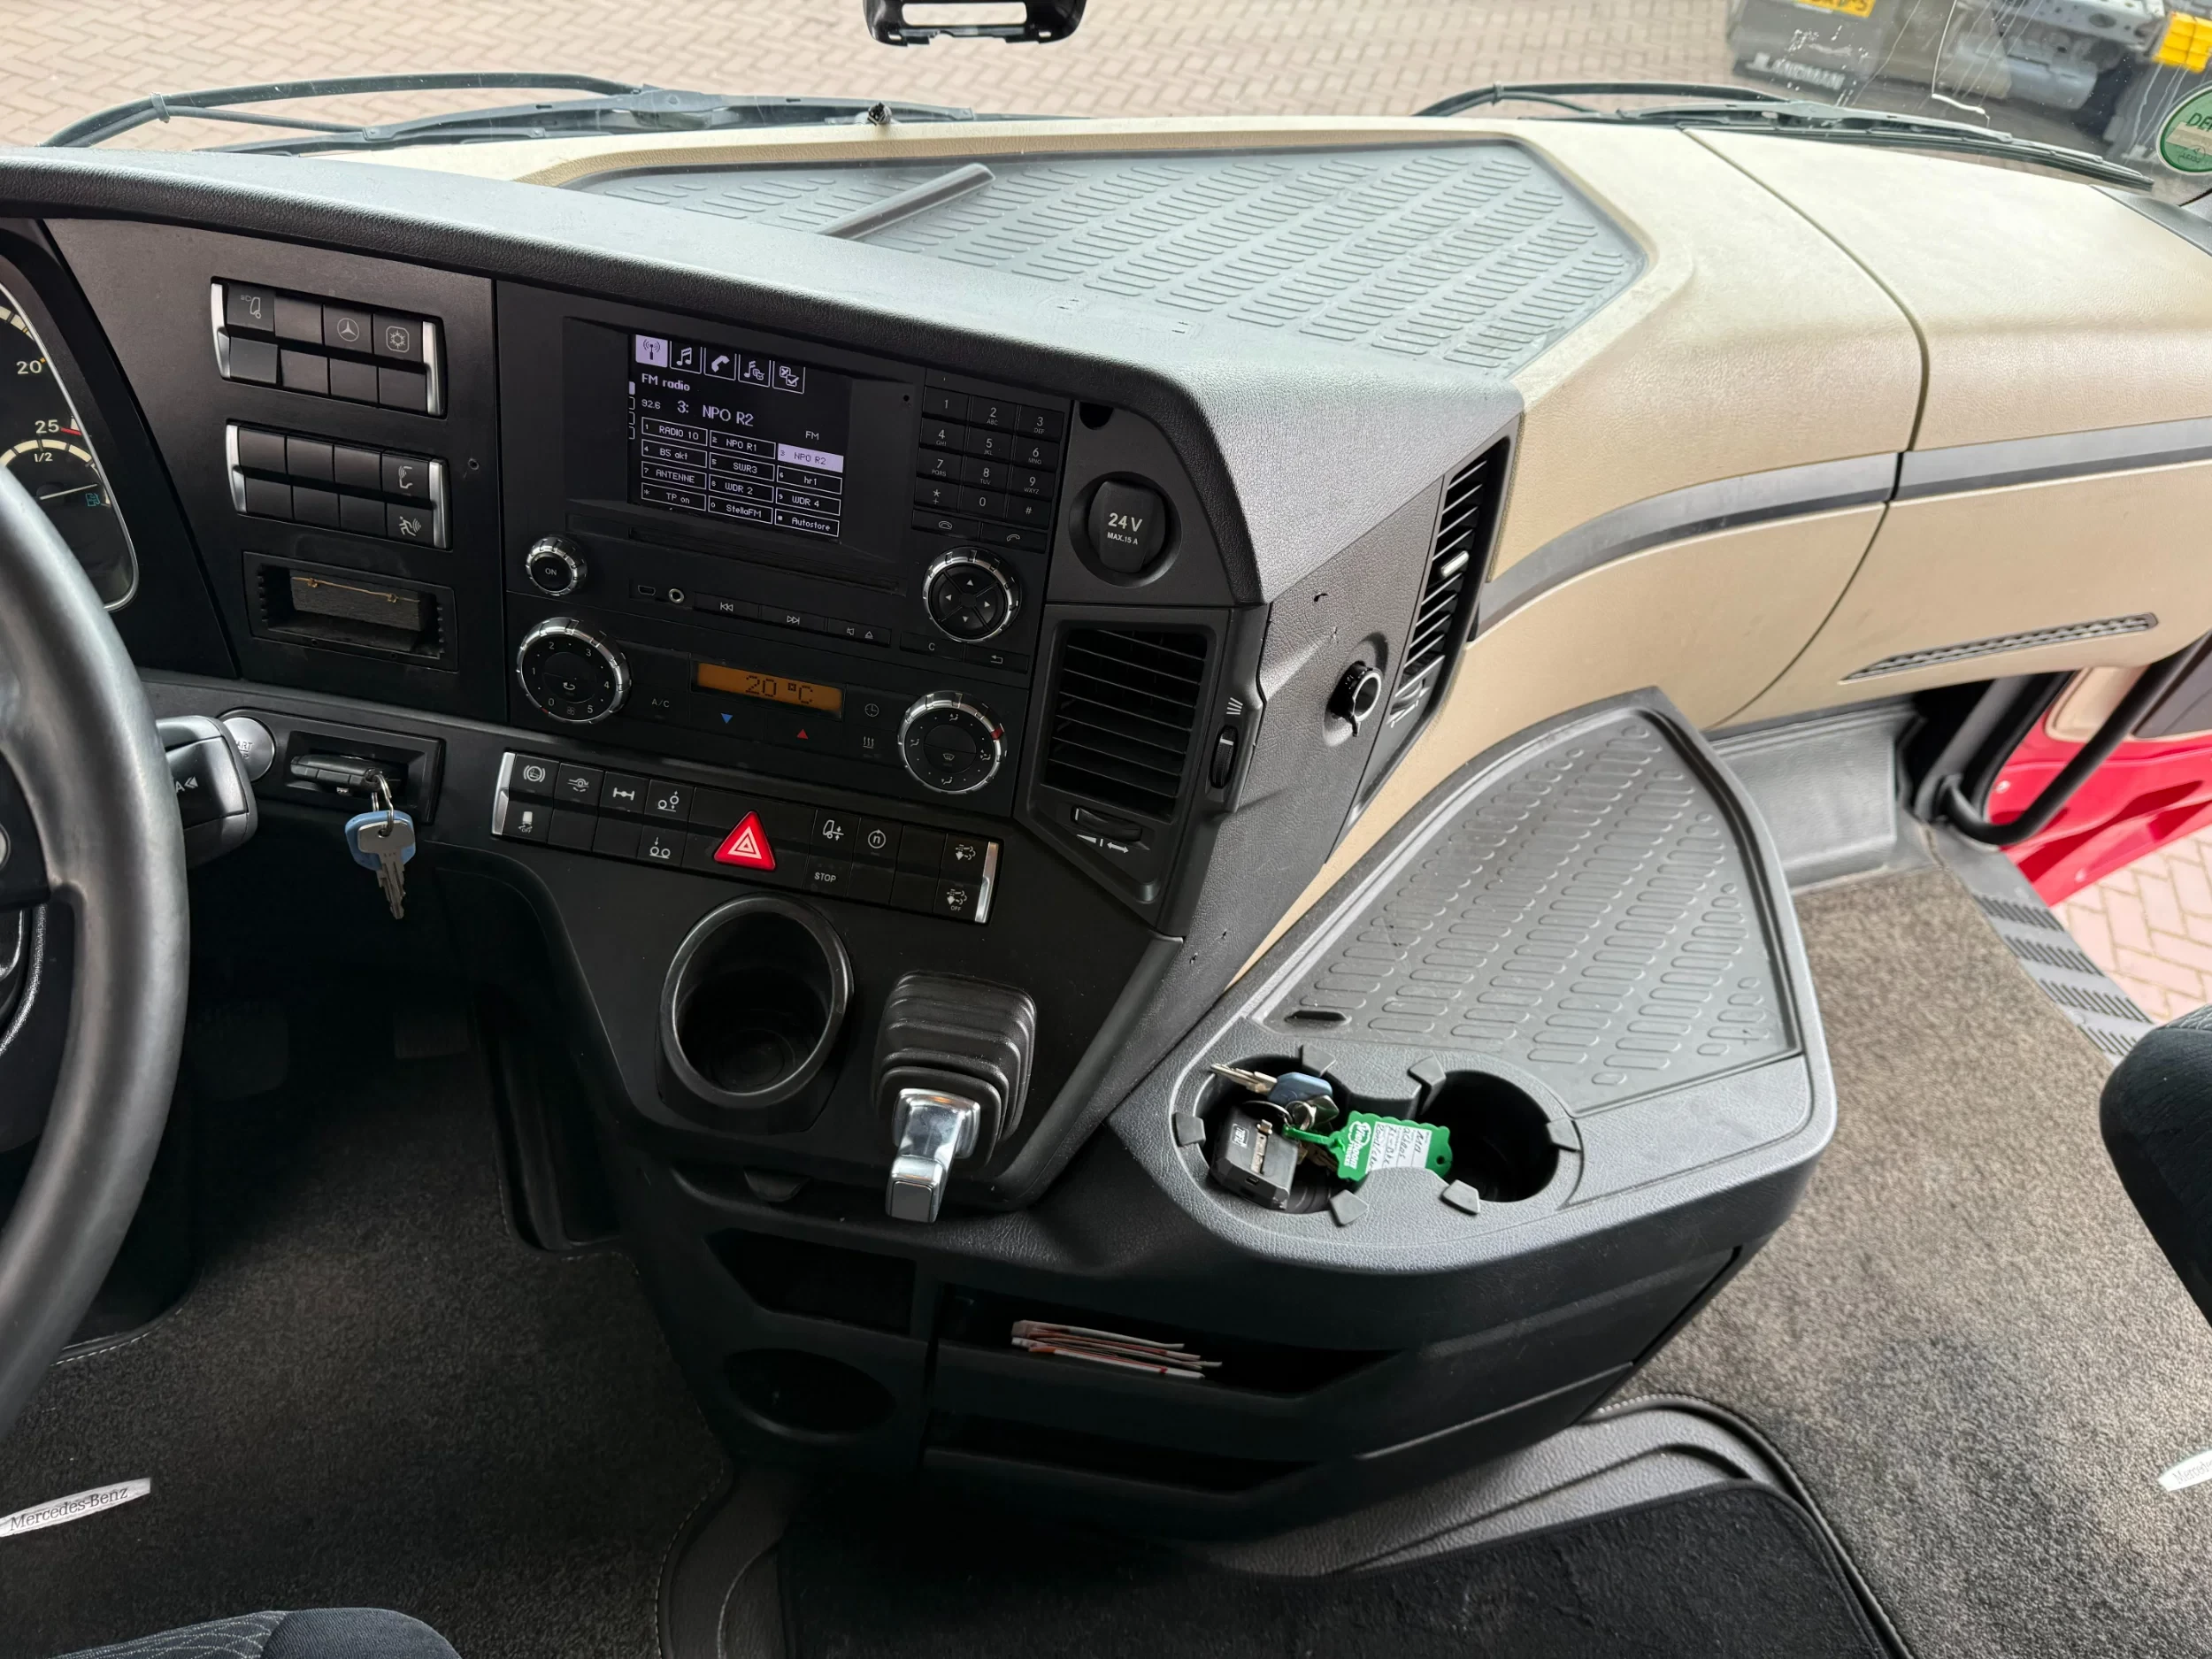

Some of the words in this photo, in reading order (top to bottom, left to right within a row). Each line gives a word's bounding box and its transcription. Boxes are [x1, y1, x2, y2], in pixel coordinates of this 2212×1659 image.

[16, 360, 42, 375] 20
[641, 373, 658, 386] FM
[662, 380, 690, 391] radio
[944, 399, 949, 409] 1
[641, 399, 661, 410] 92.6
[677, 400, 689, 413] 3:
[703, 404, 731, 422] NPO
[736, 411, 754, 426] R2
[990, 407, 997, 418] 2
[35, 419, 60, 434] 25
[1037, 417, 1043, 426] 3
[659, 425, 683, 437] RADIO
[688, 431, 699, 441] 10
[805, 431, 819, 441] FM
[938, 429, 946, 439] 4
[726, 438, 743, 449] NPO
[747, 442, 757, 451] R1
[986, 439, 992, 449] 5
[34, 452, 53, 463] 1/2
[1033, 448, 1039, 457] 6
[795, 452, 811, 463] NPO
[815, 456, 826, 465] R2
[937, 459, 944, 468] 7
[733, 462, 757, 474] SWR3
[983, 468, 990, 478] 8
[656, 469, 695, 483] ANTENNE
[725, 482, 744, 493] WDR
[1029, 477, 1036, 487] 9
[666, 492, 677, 501] TP
[792, 495, 811, 506] WDR
[979, 497, 986, 507] 0
[726, 503, 762, 518] StellaFM
[792, 517, 831, 531] Autostore
[1108, 512, 1127, 529] 24
[1131, 517, 1142, 532] V
[549, 641, 555, 650] 2
[928, 642, 935, 651] C
[586, 649, 591, 657] 3
[746, 675, 777, 697] 20
[651, 698, 670, 708] A/C
[587, 705, 593, 714] 5
[814, 872, 836, 883] STOP
[9, 1487, 128, 1531] Mercedes-Benz
